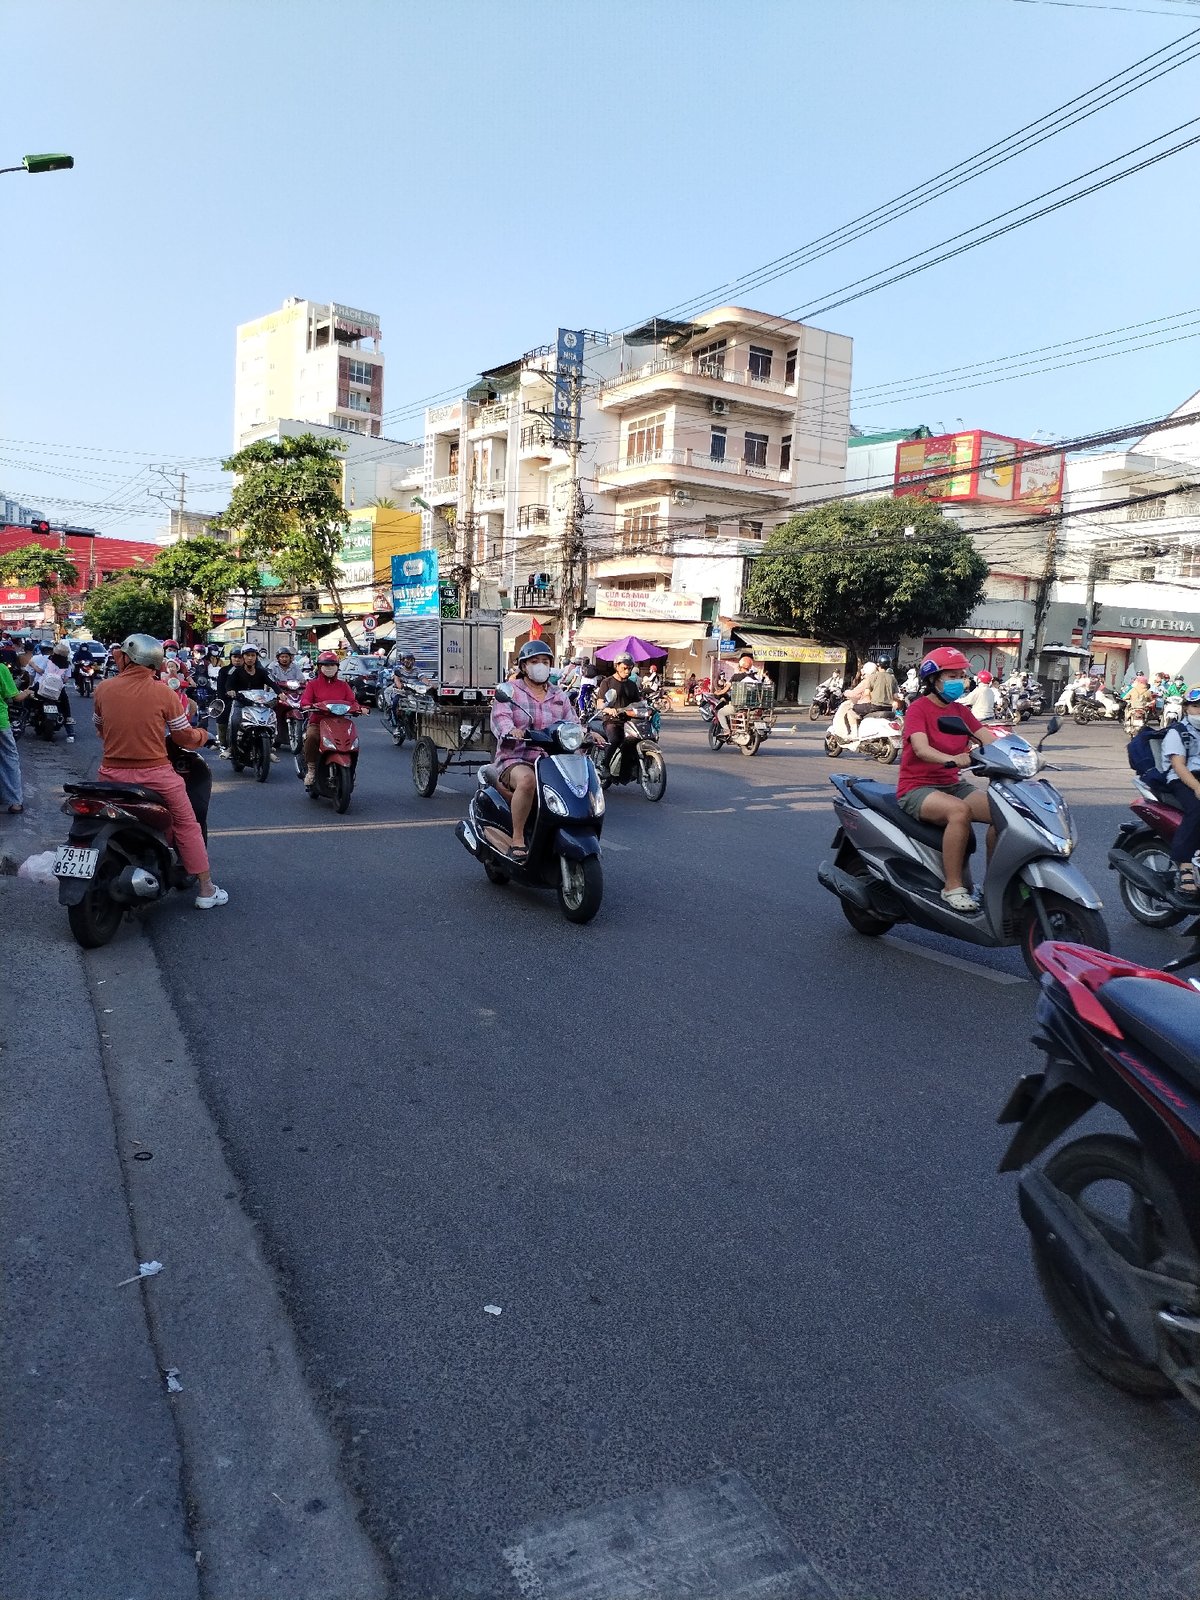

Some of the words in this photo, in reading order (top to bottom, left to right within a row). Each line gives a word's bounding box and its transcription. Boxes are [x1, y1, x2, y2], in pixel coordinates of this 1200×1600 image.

[1121, 615, 1195, 632] LOTTERIA
[62, 848, 91, 862] 79-H1
[55, 861, 91, 876] 852.44
[1119, 1051, 1188, 1108] VISION
